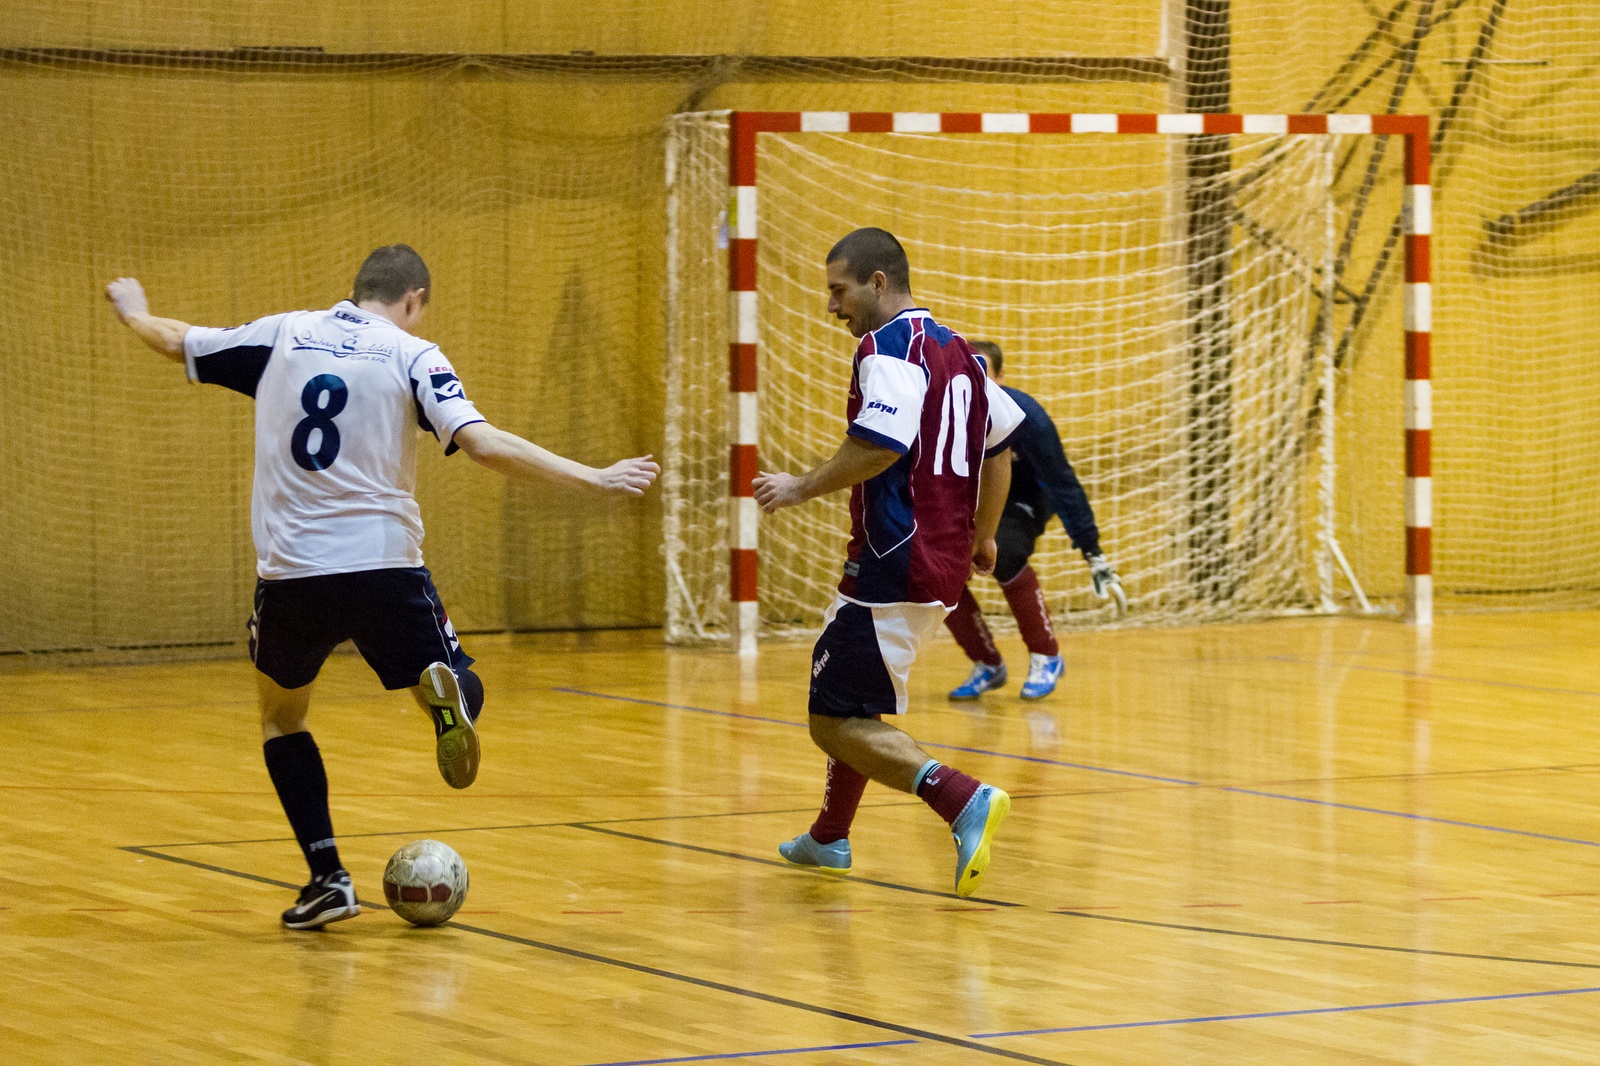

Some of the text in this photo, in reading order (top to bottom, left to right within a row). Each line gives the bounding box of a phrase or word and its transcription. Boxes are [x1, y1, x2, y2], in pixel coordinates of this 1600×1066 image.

[291, 373, 348, 472] 8
[867, 401, 898, 415] Royal
[933, 373, 972, 477] 10
[813, 649, 830, 678] Royal
